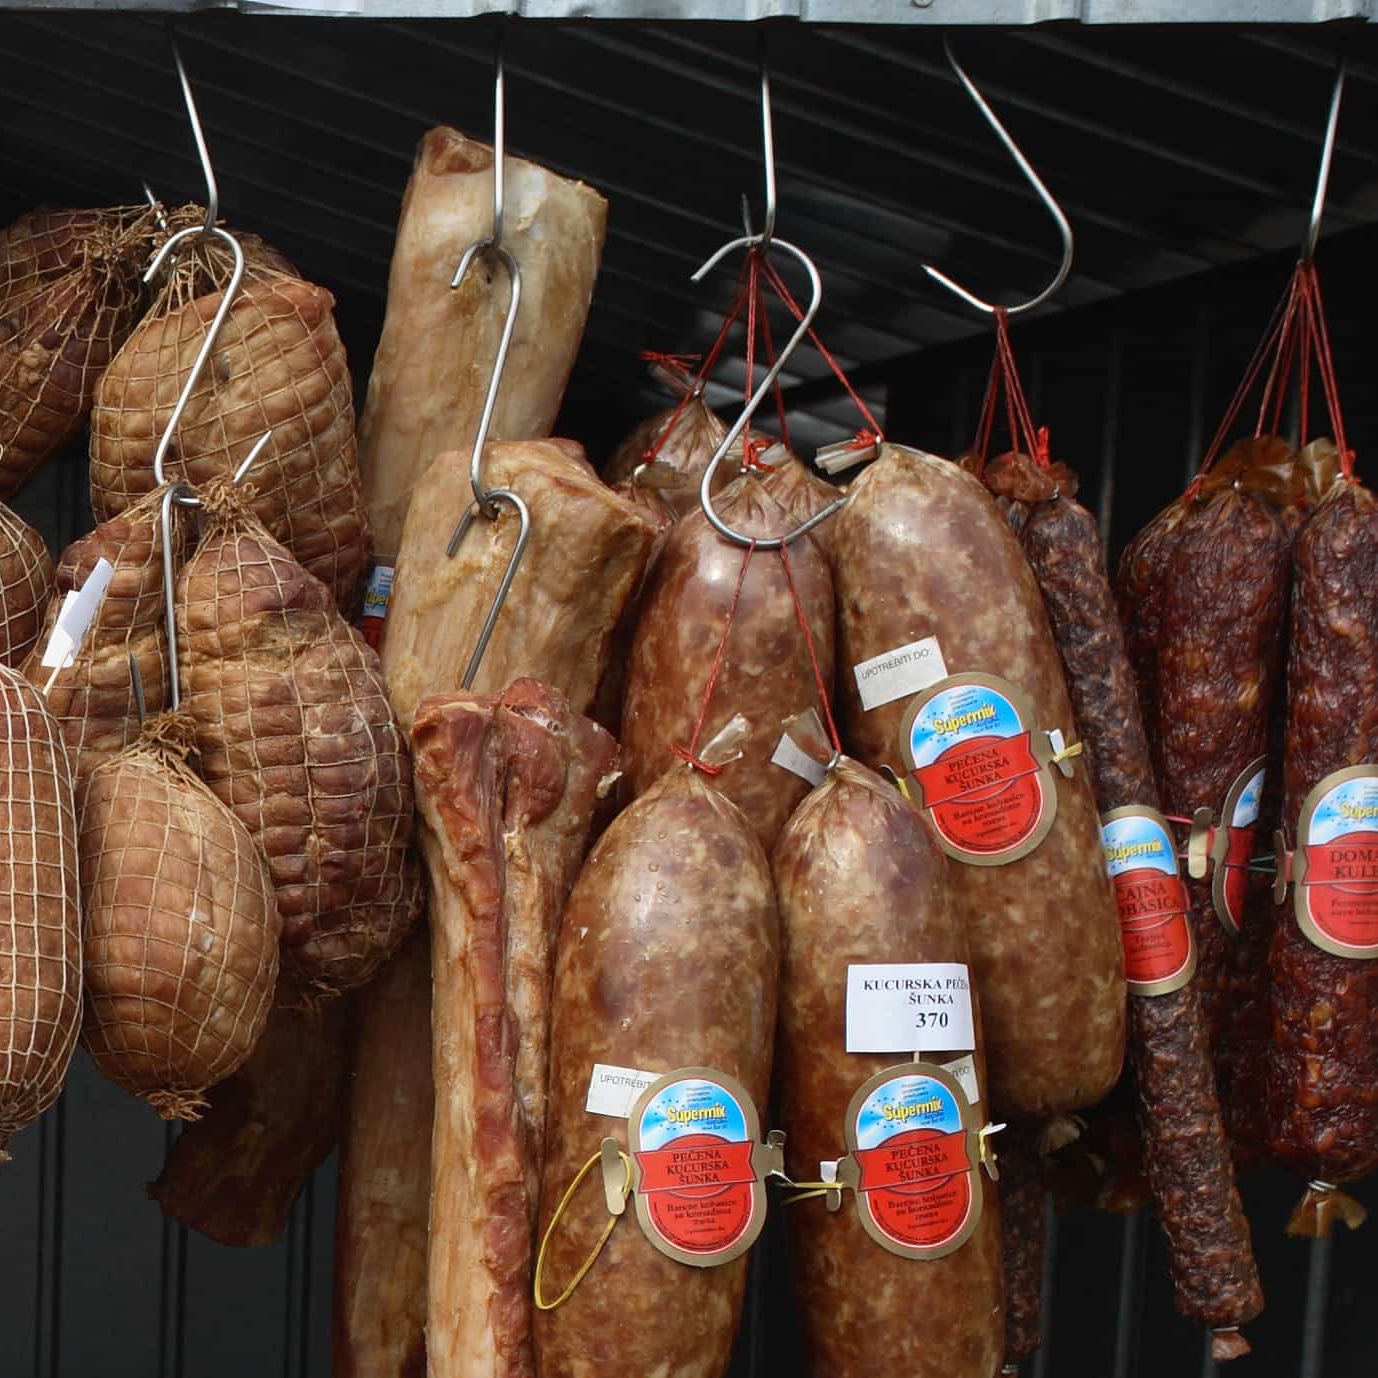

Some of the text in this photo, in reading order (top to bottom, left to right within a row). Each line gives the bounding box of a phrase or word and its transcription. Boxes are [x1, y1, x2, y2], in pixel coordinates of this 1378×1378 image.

[861, 648, 933, 681] UPOTREBITI DO:
[932, 703, 996, 736] Supermix
[947, 748, 999, 773] PEČENA
[945, 756, 1010, 785] KUCURSKA
[958, 772, 1005, 793] ŠUNKA
[863, 979, 942, 992] KUCURSKA
[908, 992, 955, 1006] ŠUNKA
[915, 1012, 949, 1029] 370
[667, 1102, 725, 1124] Supermix
[882, 1095, 943, 1123] Supermix
[672, 1149, 722, 1162] PEČENA
[890, 1143, 941, 1161] PEČENA
[666, 1162, 730, 1176] KUCURSKA
[885, 1153, 949, 1173] KUCURSKA
[678, 1173, 721, 1185] ŠUNKA
[899, 1165, 941, 1182] ŠUNKA
